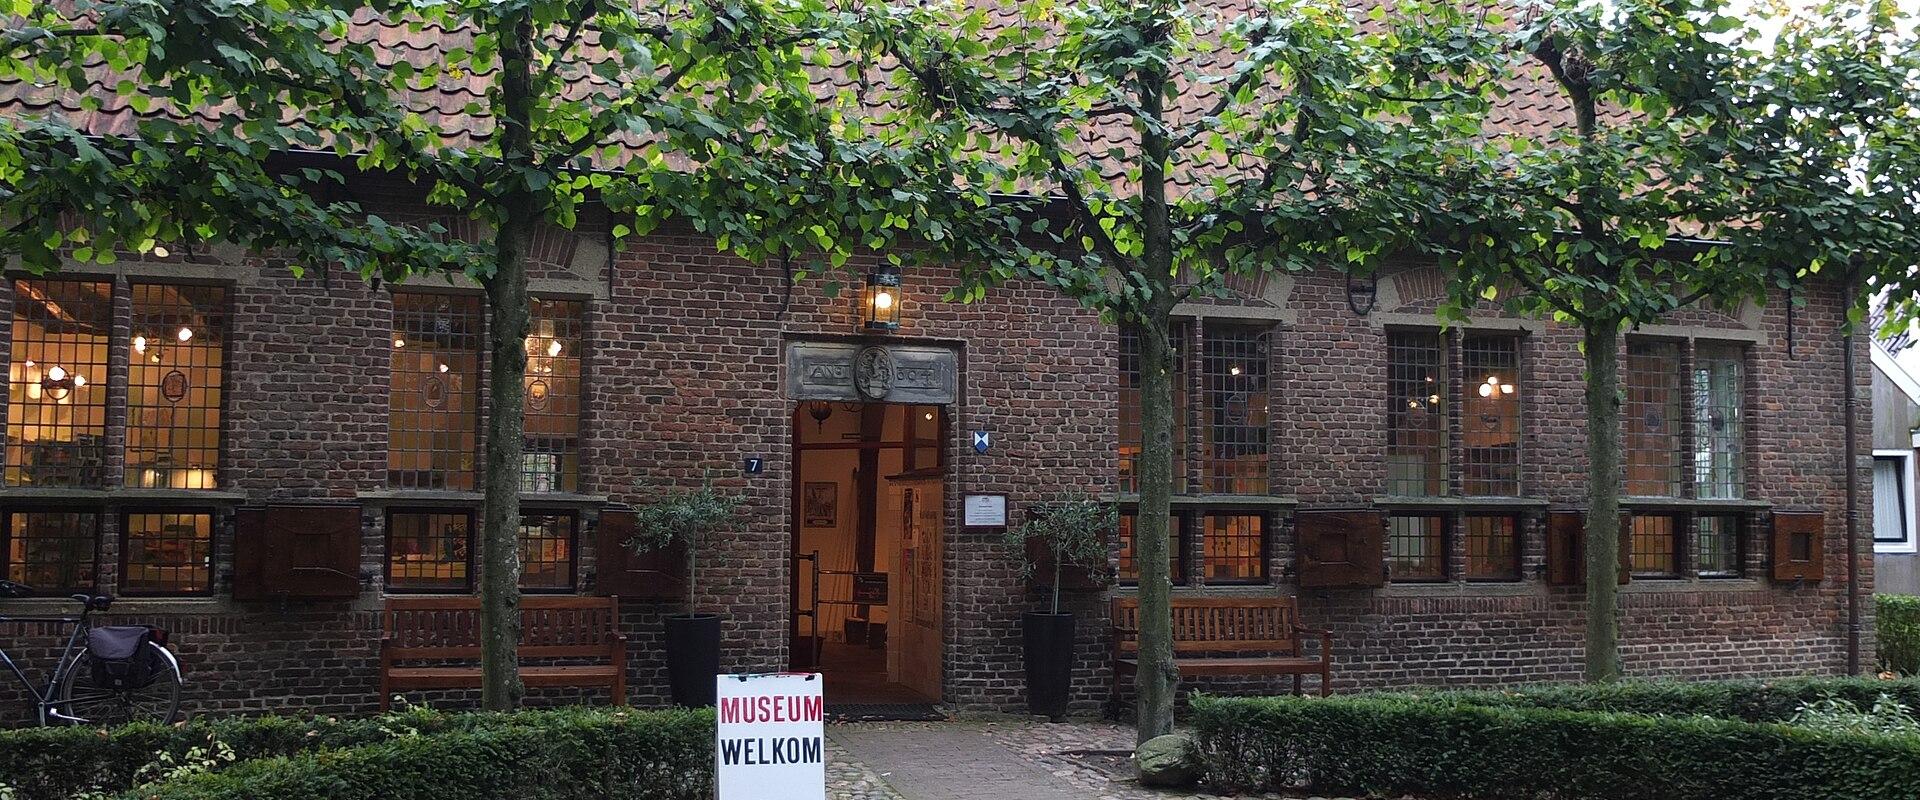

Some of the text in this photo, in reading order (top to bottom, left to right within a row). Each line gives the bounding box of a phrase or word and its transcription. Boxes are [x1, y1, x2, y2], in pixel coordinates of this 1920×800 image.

[750, 459, 758, 472] 7
[721, 695, 822, 723] MUSEUM
[720, 737, 821, 765] WELKOM
